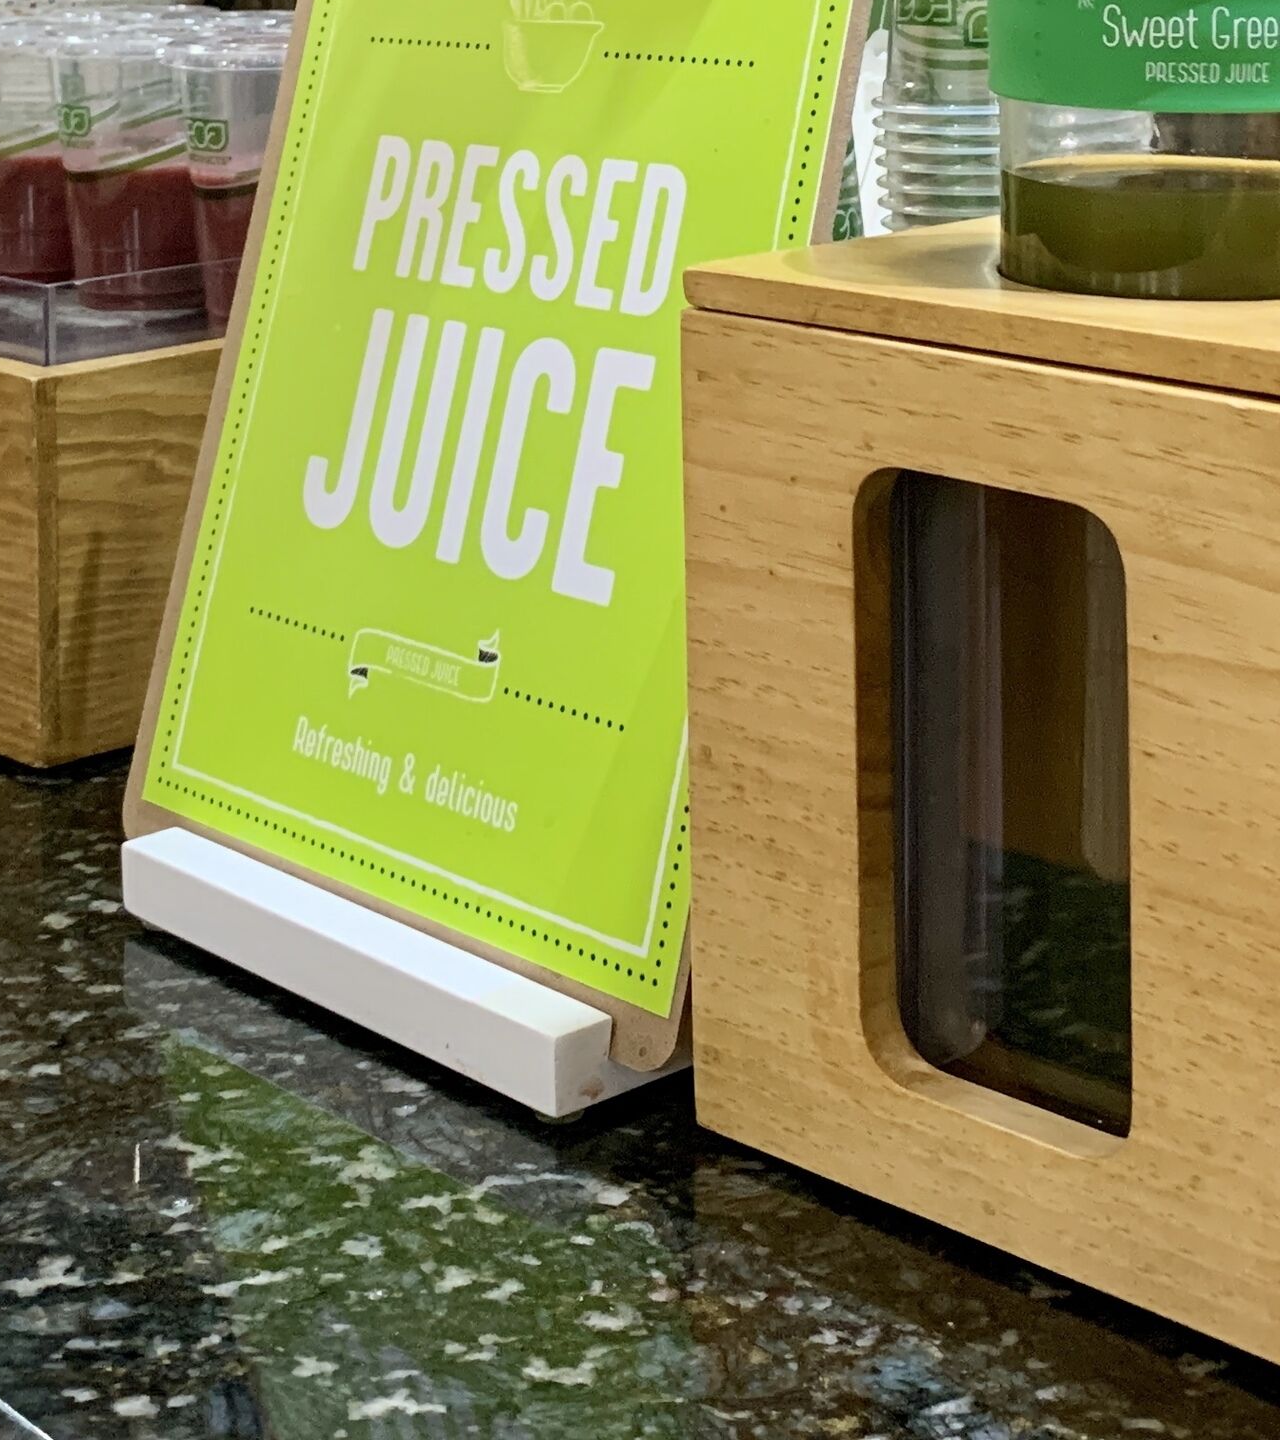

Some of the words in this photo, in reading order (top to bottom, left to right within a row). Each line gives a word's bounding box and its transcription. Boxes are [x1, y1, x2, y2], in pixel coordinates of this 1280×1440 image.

[1102, 4, 1199, 50] Sweet
[1145, 61, 1220, 84] PRESSED
[1225, 62, 1271, 84] JUICE
[353, 134, 687, 317] PRESSED
[303, 308, 656, 608] JUICE
[385, 646, 429, 676] PRESSED
[431, 660, 462, 687] JUICE
[292, 715, 393, 795] Refreshing
[398, 752, 416, 794] &
[424, 763, 519, 832] delicious
